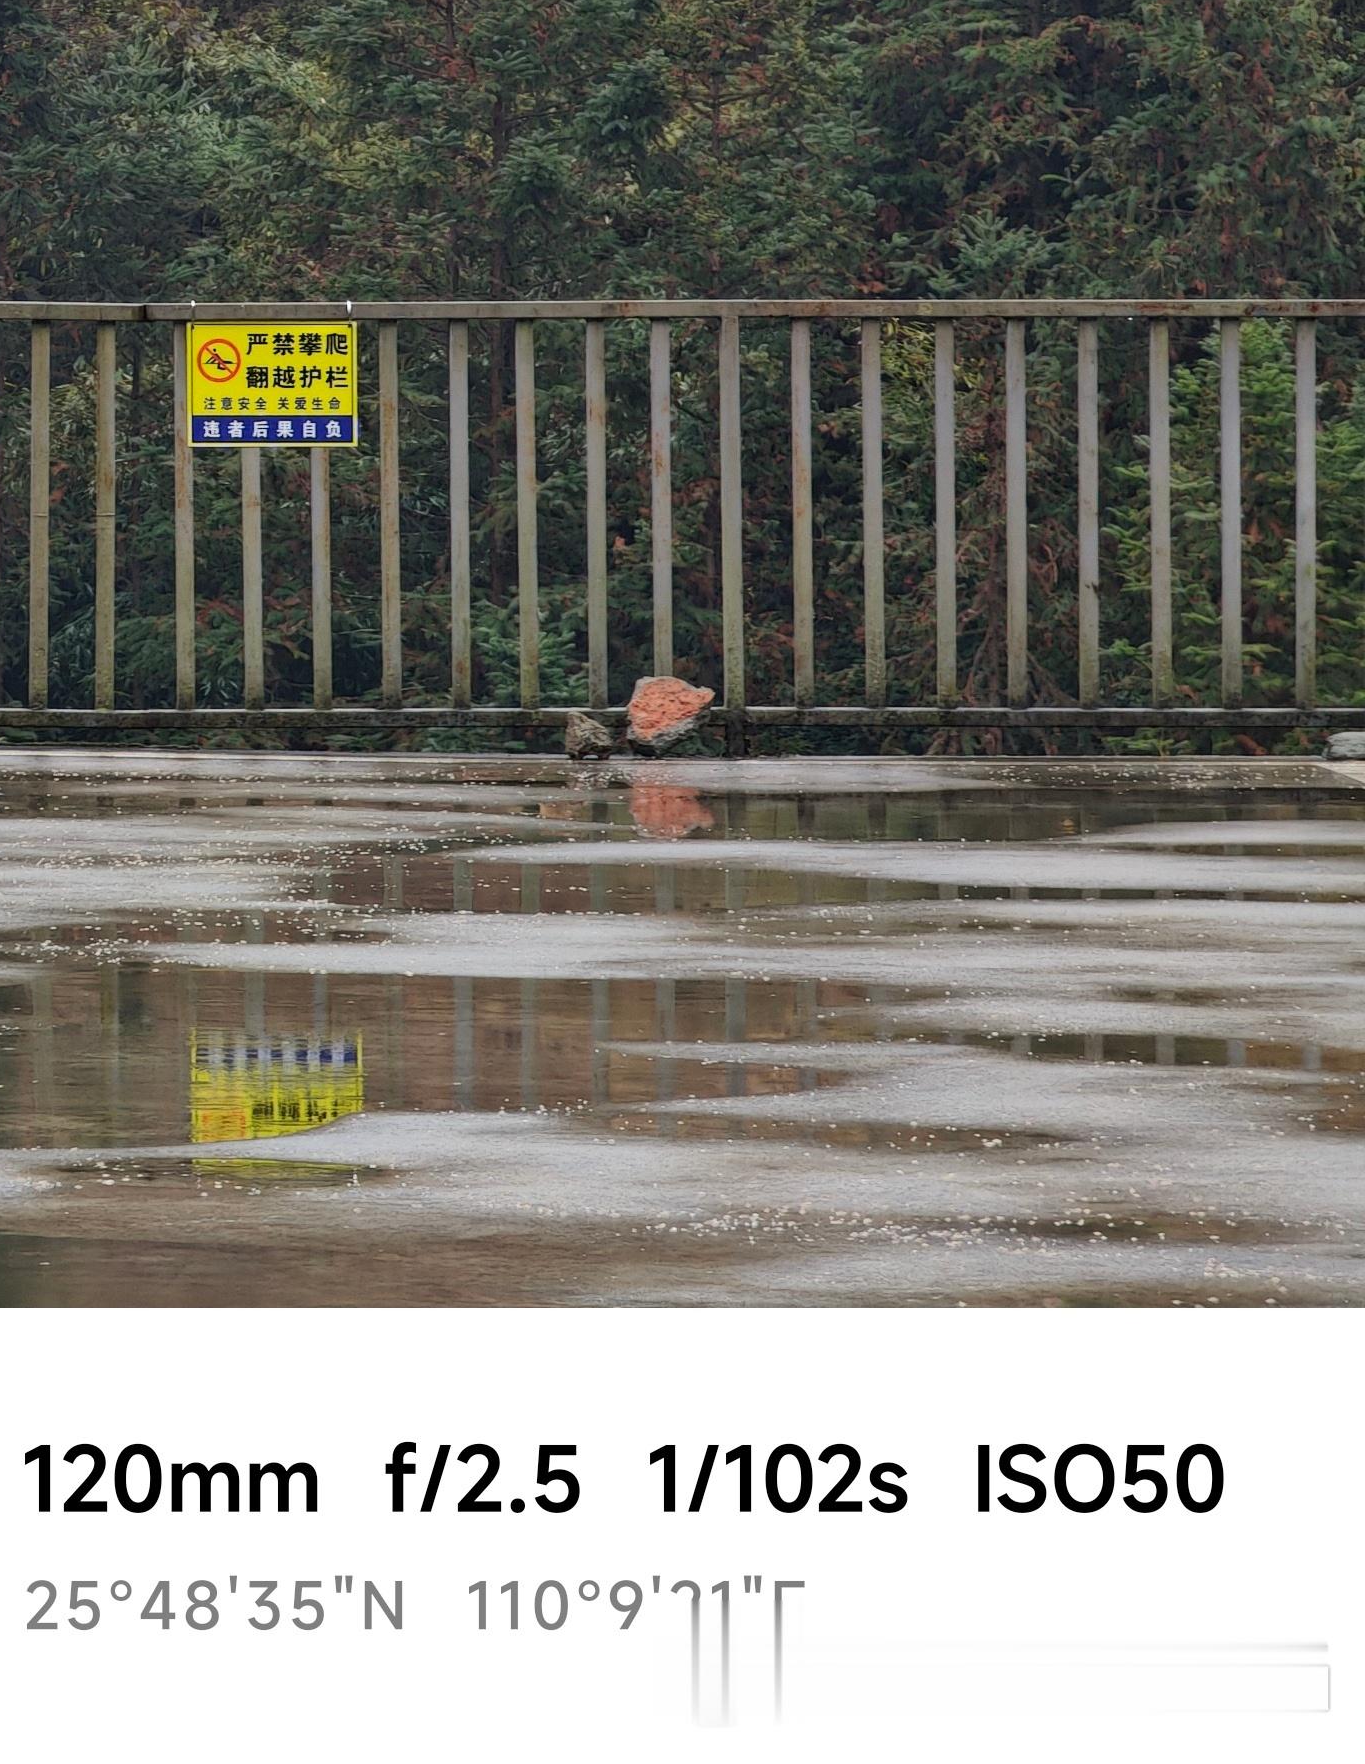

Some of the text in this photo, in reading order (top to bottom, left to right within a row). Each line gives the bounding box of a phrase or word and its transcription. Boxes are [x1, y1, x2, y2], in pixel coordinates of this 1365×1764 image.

[246, 333, 348, 355] 严禁攀爬
[246, 366, 348, 388] 翻越护栏
[204, 397, 341, 410] 注意安全 关爱生命
[203, 420, 342, 438] 违者后果自负
